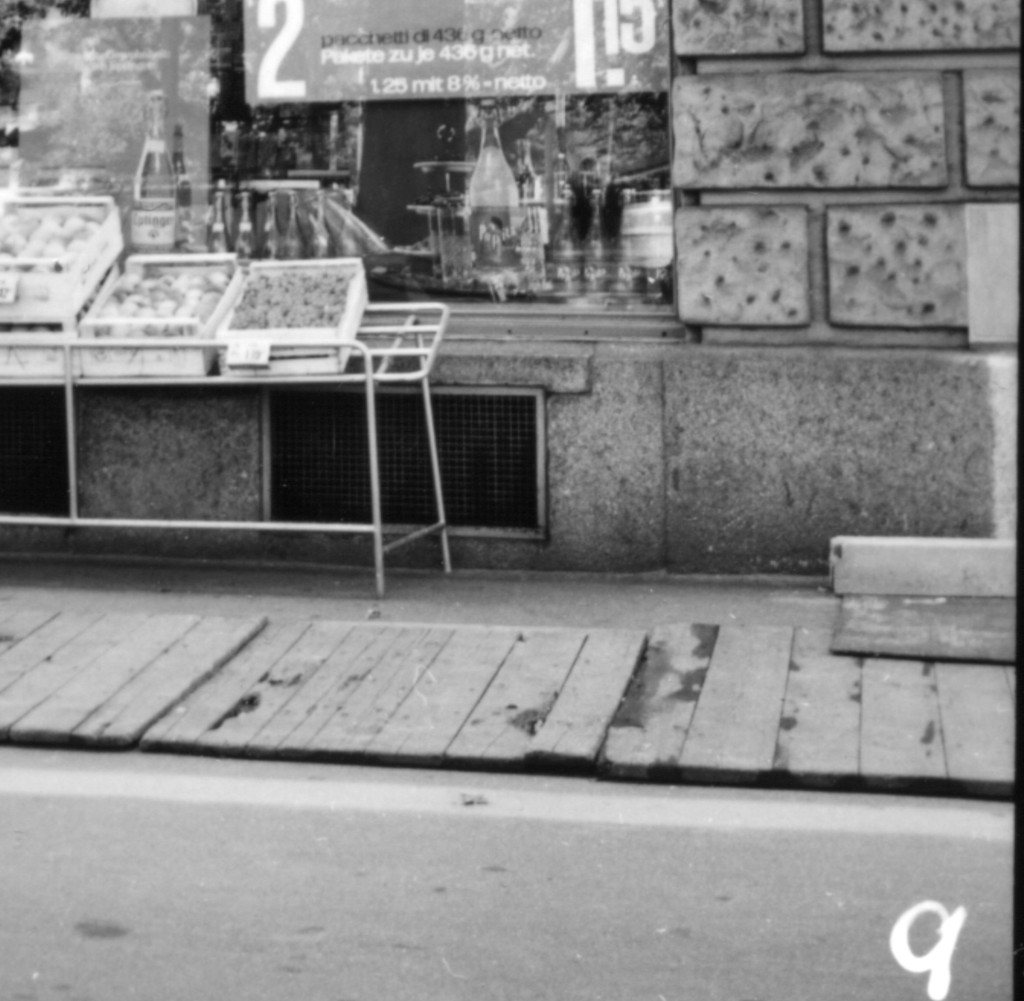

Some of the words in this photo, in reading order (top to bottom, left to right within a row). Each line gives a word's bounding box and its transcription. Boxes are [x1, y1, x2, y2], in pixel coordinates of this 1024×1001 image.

[321, 29, 409, 48] pacchetti
[413, 27, 429, 44] di
[490, 25, 543, 42] netto
[321, 47, 385, 65] Pakete
[389, 48, 413, 62] zu
[414, 46, 435, 65] je
[480, 45, 494, 64] g
[412, 75, 443, 93] mit
[494, 73, 548, 93] netto
